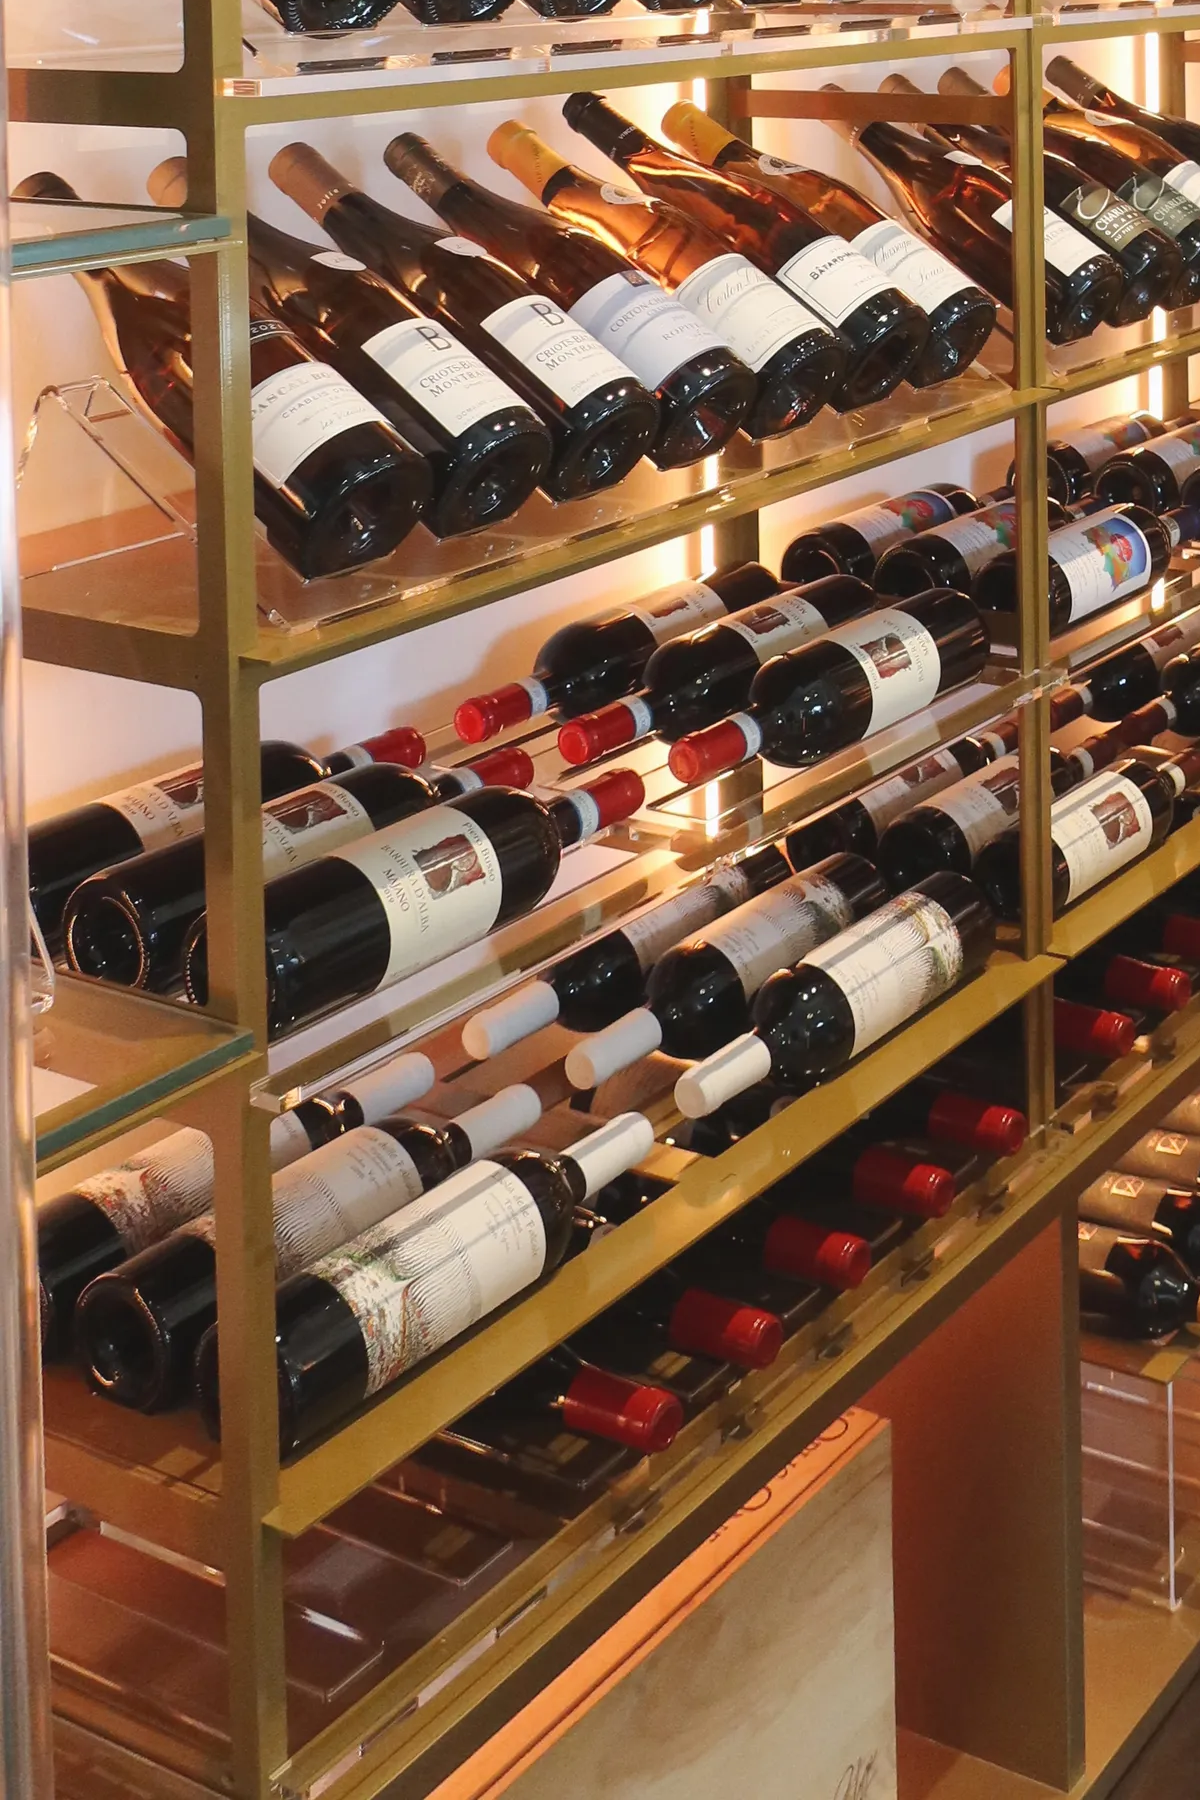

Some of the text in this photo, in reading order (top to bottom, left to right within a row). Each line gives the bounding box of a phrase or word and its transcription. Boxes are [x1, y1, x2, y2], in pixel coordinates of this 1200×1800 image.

[250, 322, 283, 334] 2021
[251, 376, 310, 421] PASCAL
[282, 389, 330, 419] CHABLIS
[380, 844, 418, 888] BARBERA
